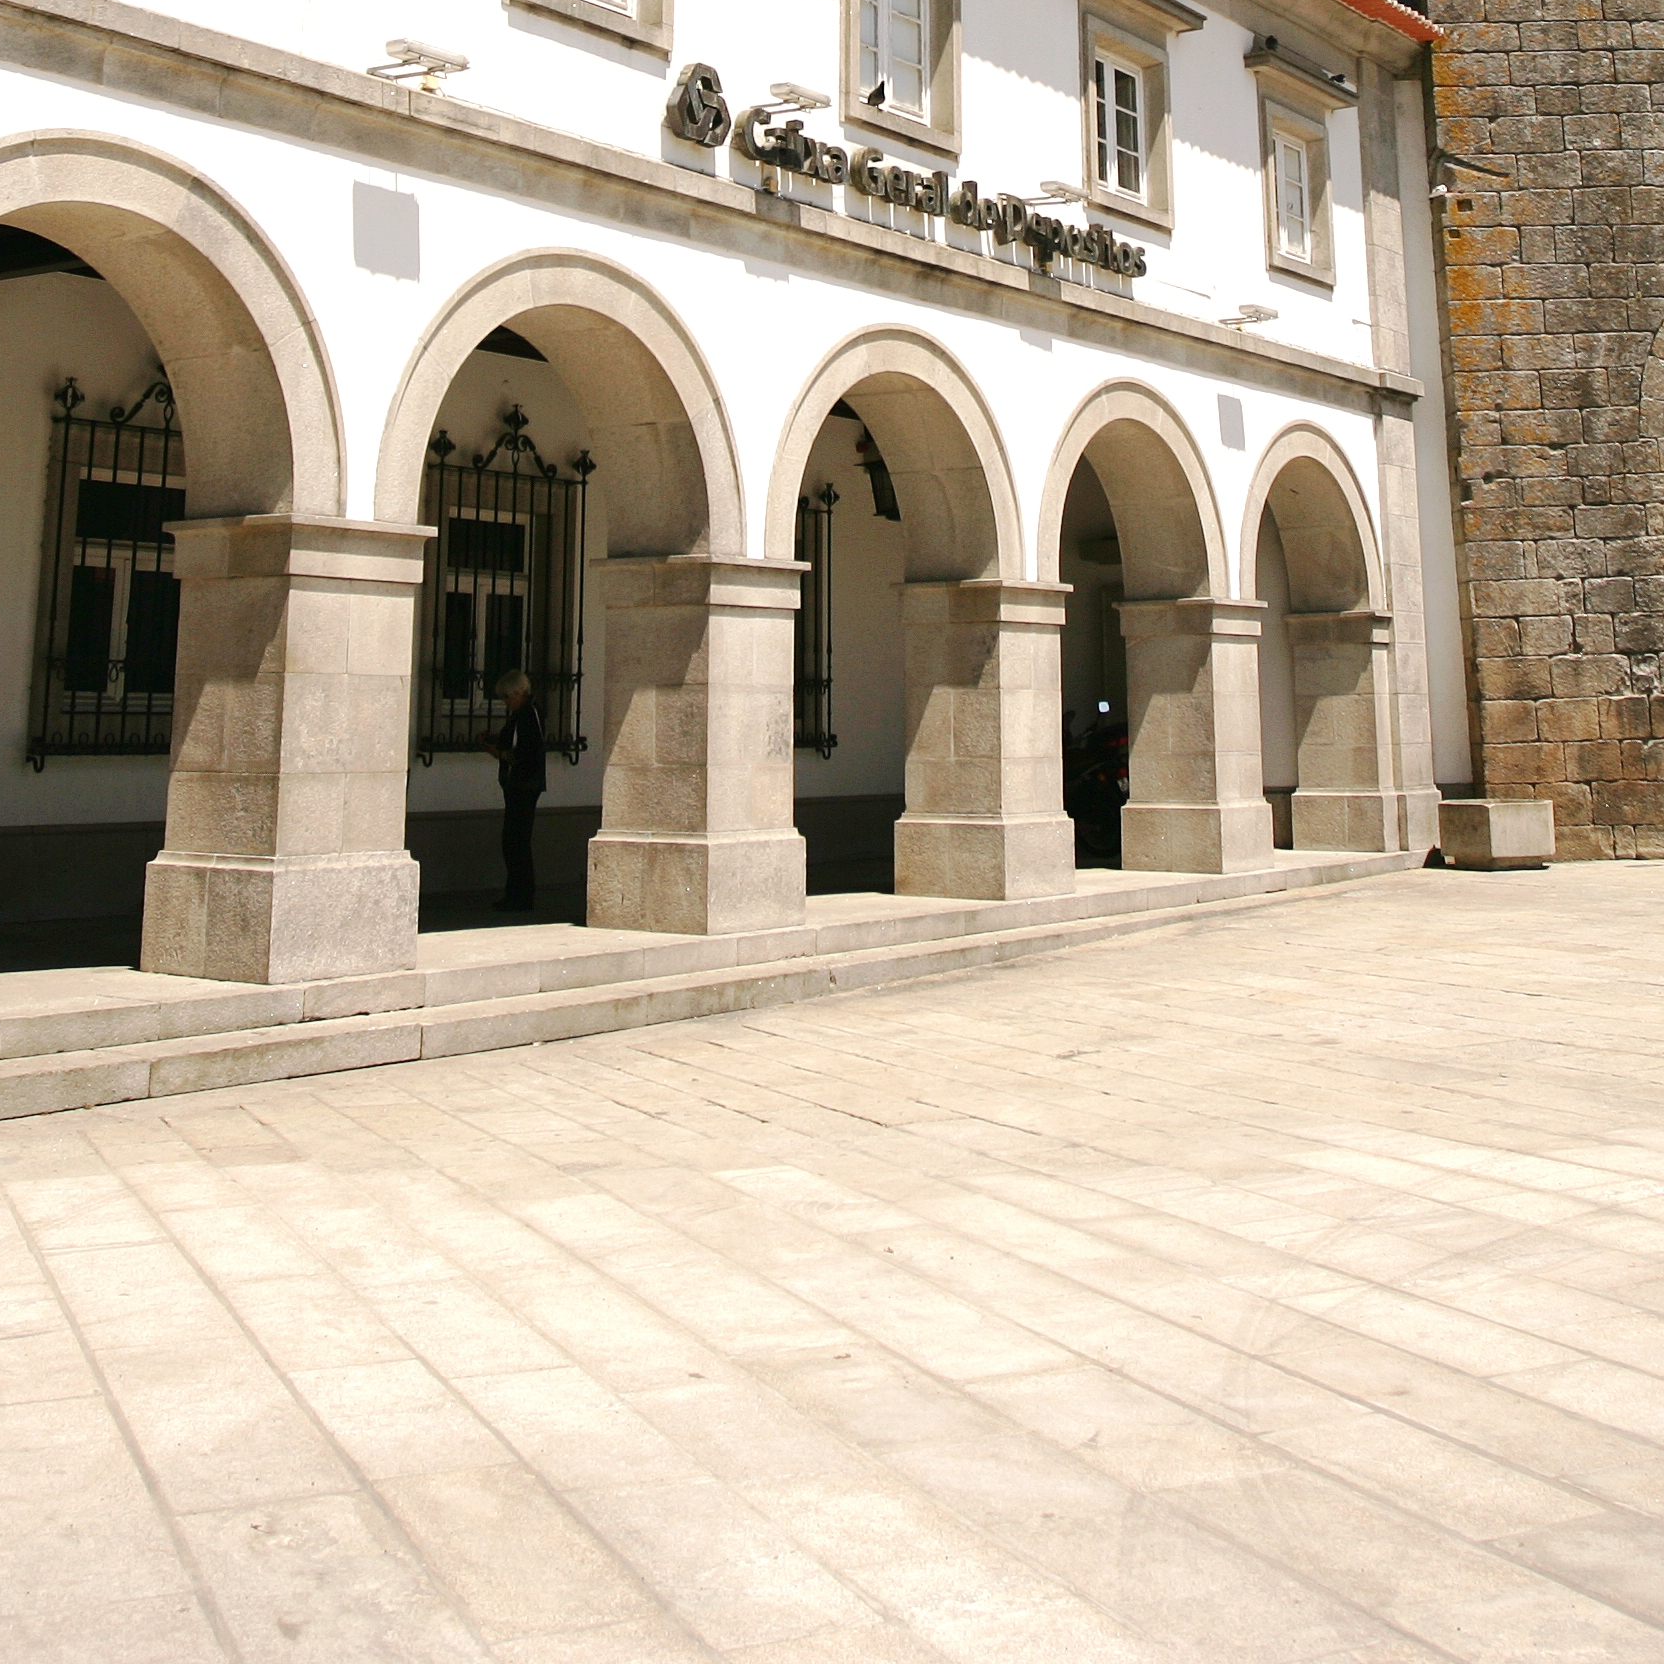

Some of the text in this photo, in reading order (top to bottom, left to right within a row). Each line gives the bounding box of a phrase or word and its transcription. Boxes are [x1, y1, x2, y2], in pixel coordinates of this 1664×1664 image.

[731, 108, 848, 184] Caixa
[850, 147, 949, 217] Geral
[949, 180, 1000, 230] de
